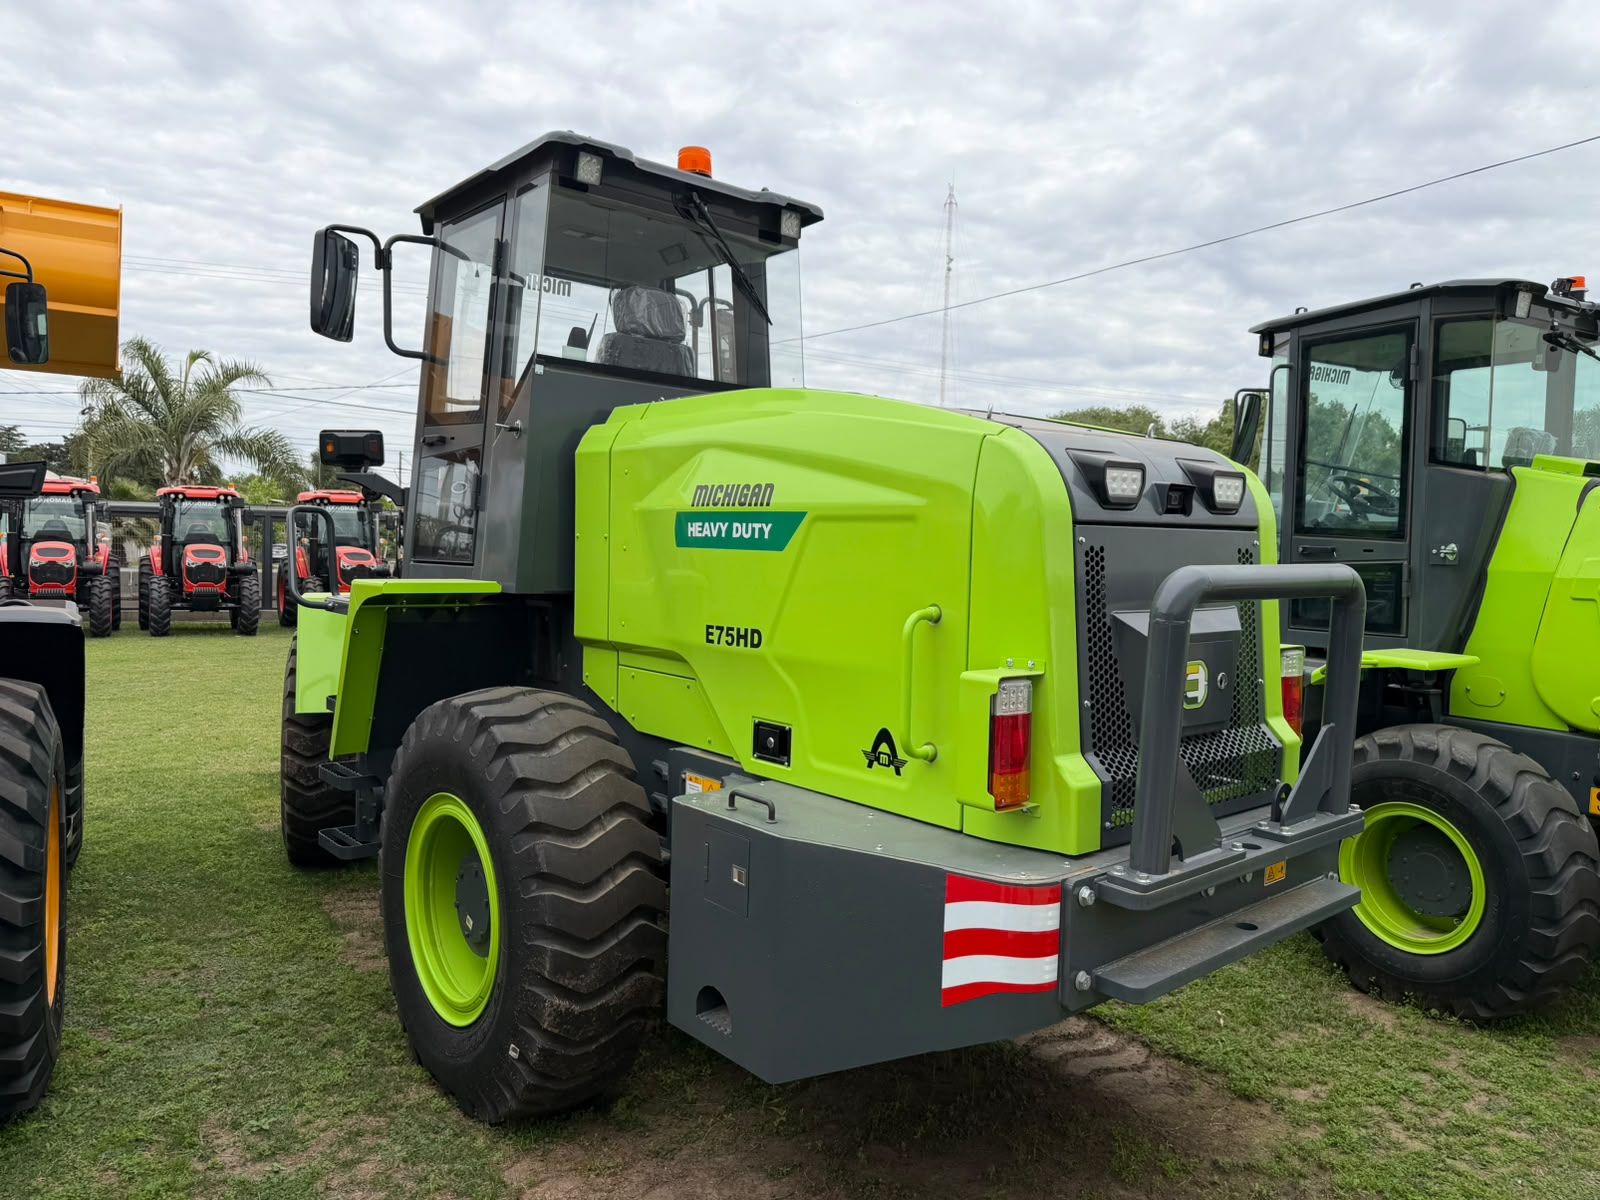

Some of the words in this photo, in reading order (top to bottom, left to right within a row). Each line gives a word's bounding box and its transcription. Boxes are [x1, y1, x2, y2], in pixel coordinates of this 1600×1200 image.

[691, 483, 774, 507] MICHIGAN
[687, 522, 728, 537] HEAVY
[732, 522, 772, 539] DUTY
[705, 624, 762, 649] E75HD
